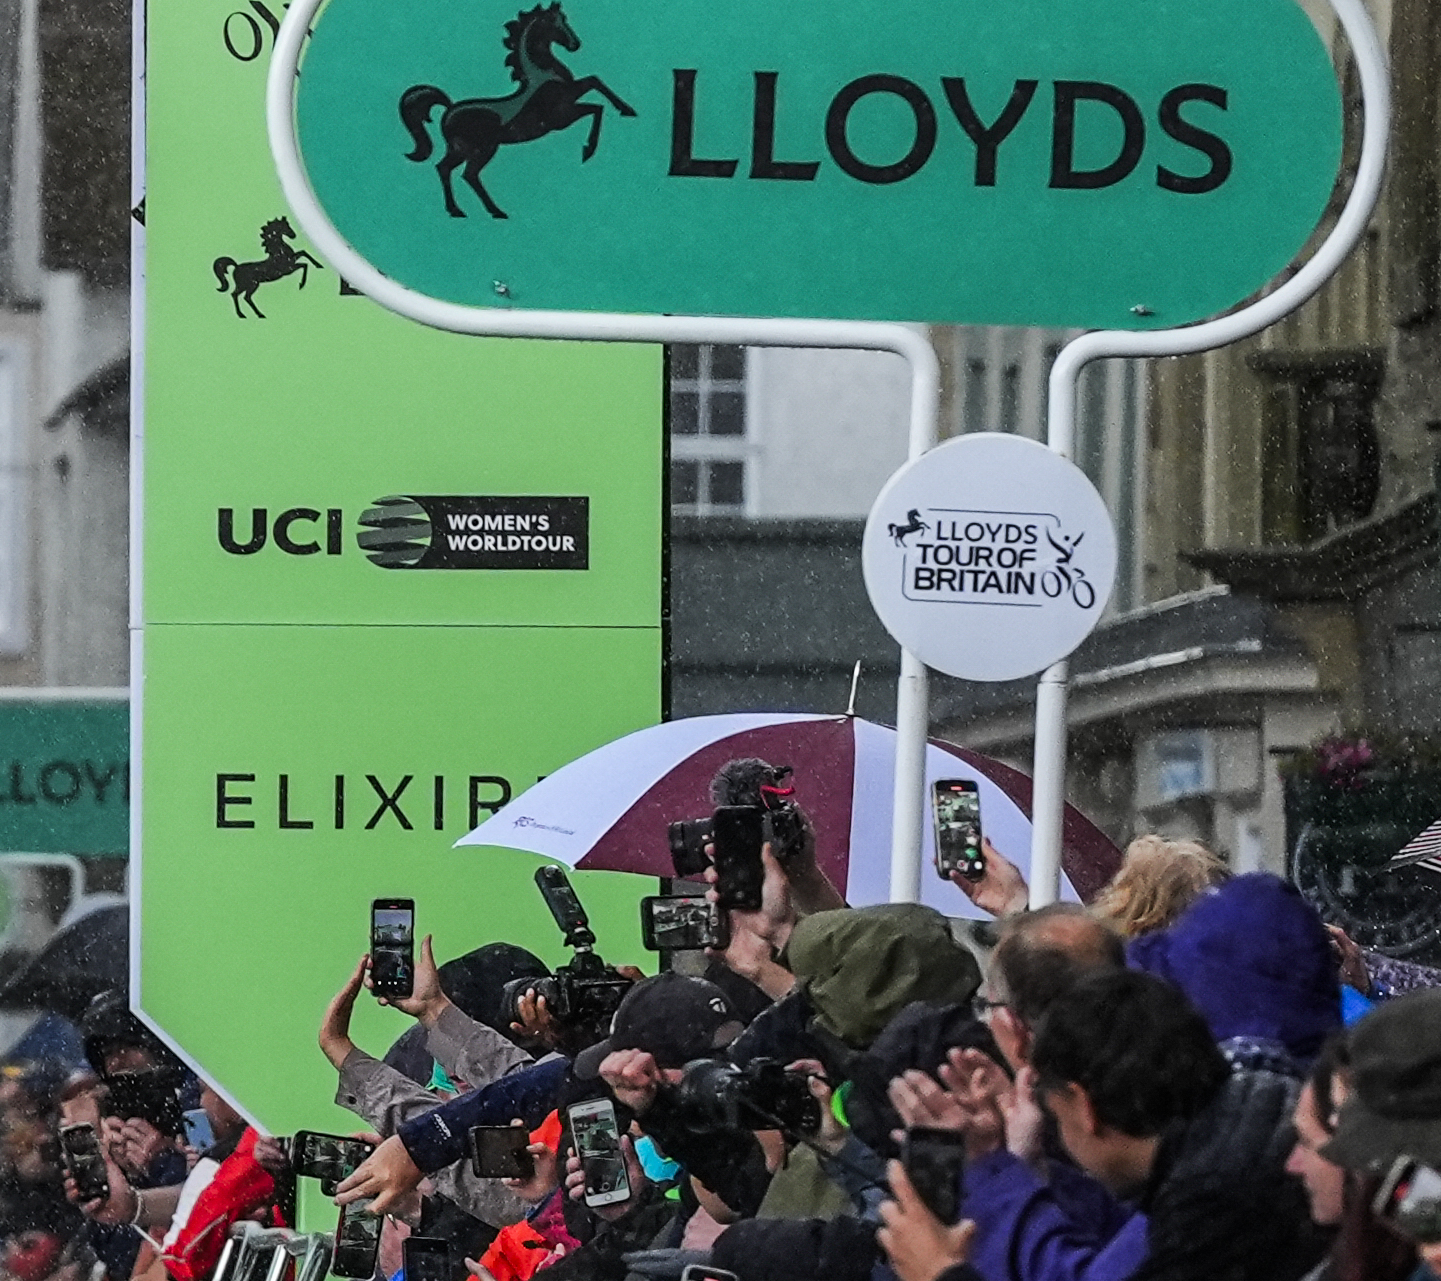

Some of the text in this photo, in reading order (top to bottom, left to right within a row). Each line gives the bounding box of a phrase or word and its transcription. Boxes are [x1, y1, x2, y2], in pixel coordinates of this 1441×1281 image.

[667, 68, 1234, 196] LLOYDS
[217, 507, 551, 555] UCI WOMEN'S
[447, 534, 576, 553] WORLDTOUR
[936, 520, 1039, 545] LLOYDS
[916, 542, 1037, 569] TOUR OF
[913, 567, 1036, 596] BRITAIN
[216, 772, 546, 831] ELIXIR
